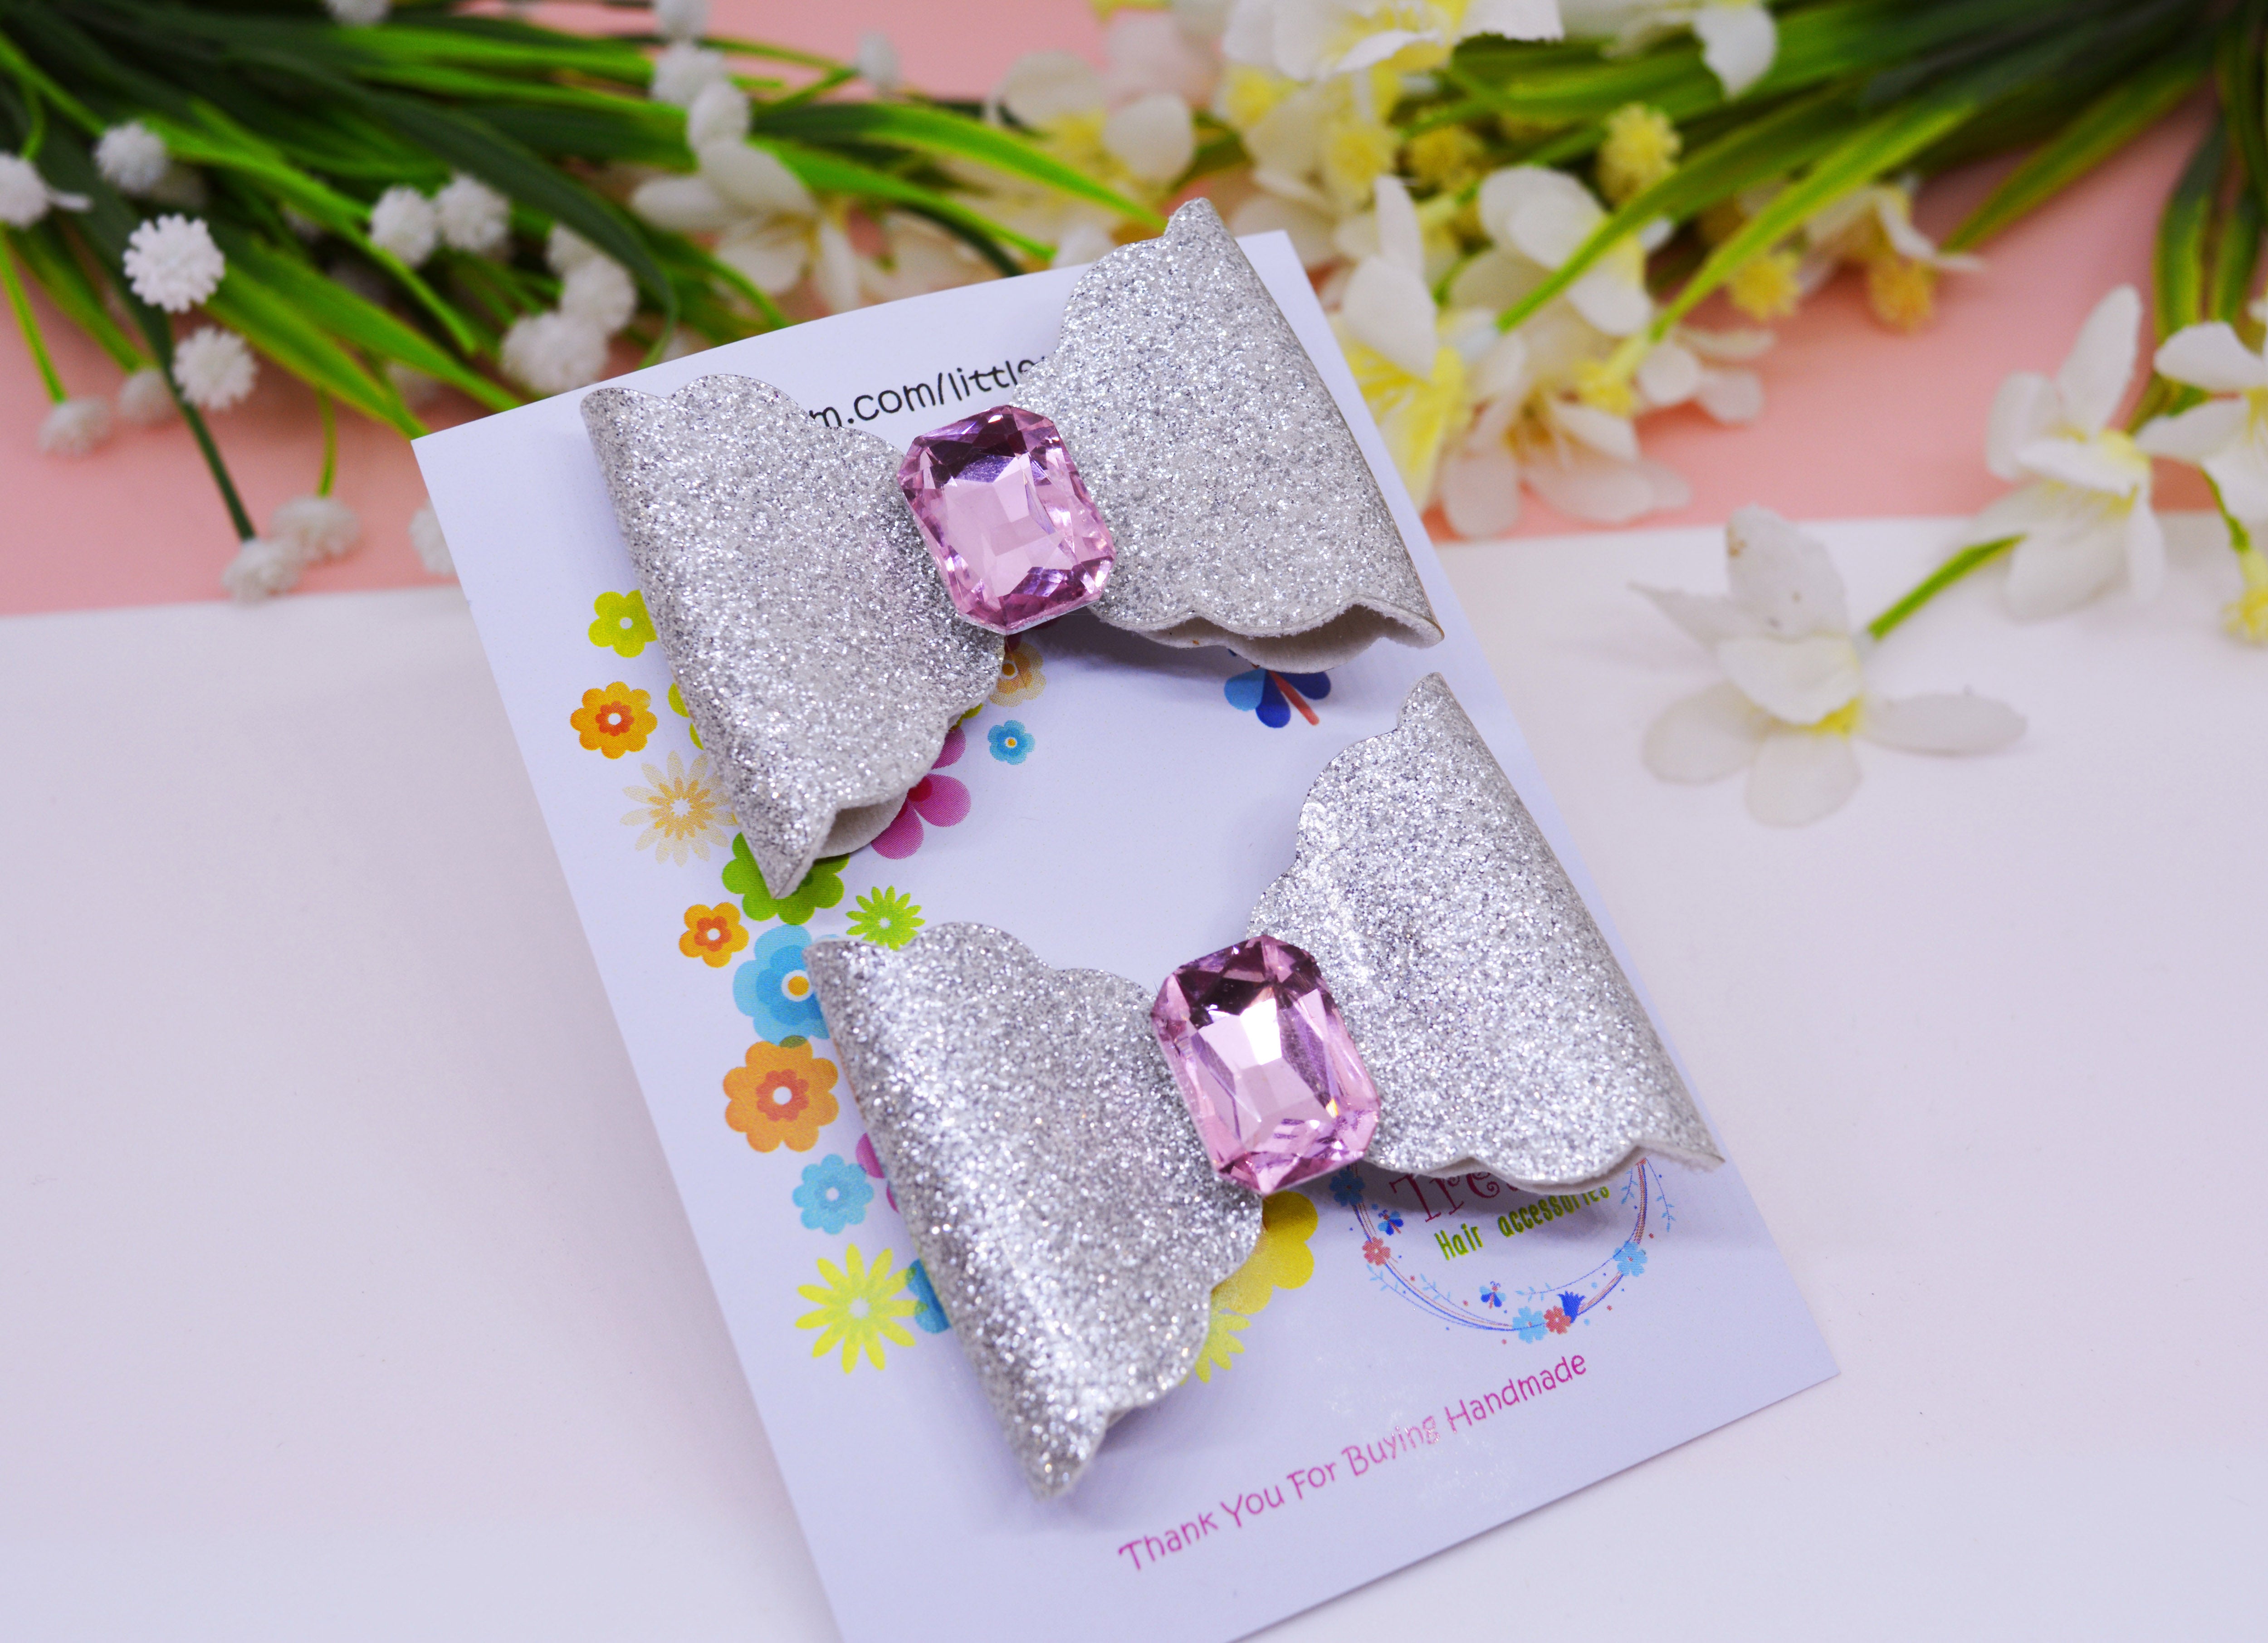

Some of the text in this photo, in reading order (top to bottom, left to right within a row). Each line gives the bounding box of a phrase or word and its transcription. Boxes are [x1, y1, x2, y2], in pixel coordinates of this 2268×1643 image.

[1434, 1223, 1484, 1261] Hair
[1117, 1354, 1587, 1570] Thank You For Buying Handmade
